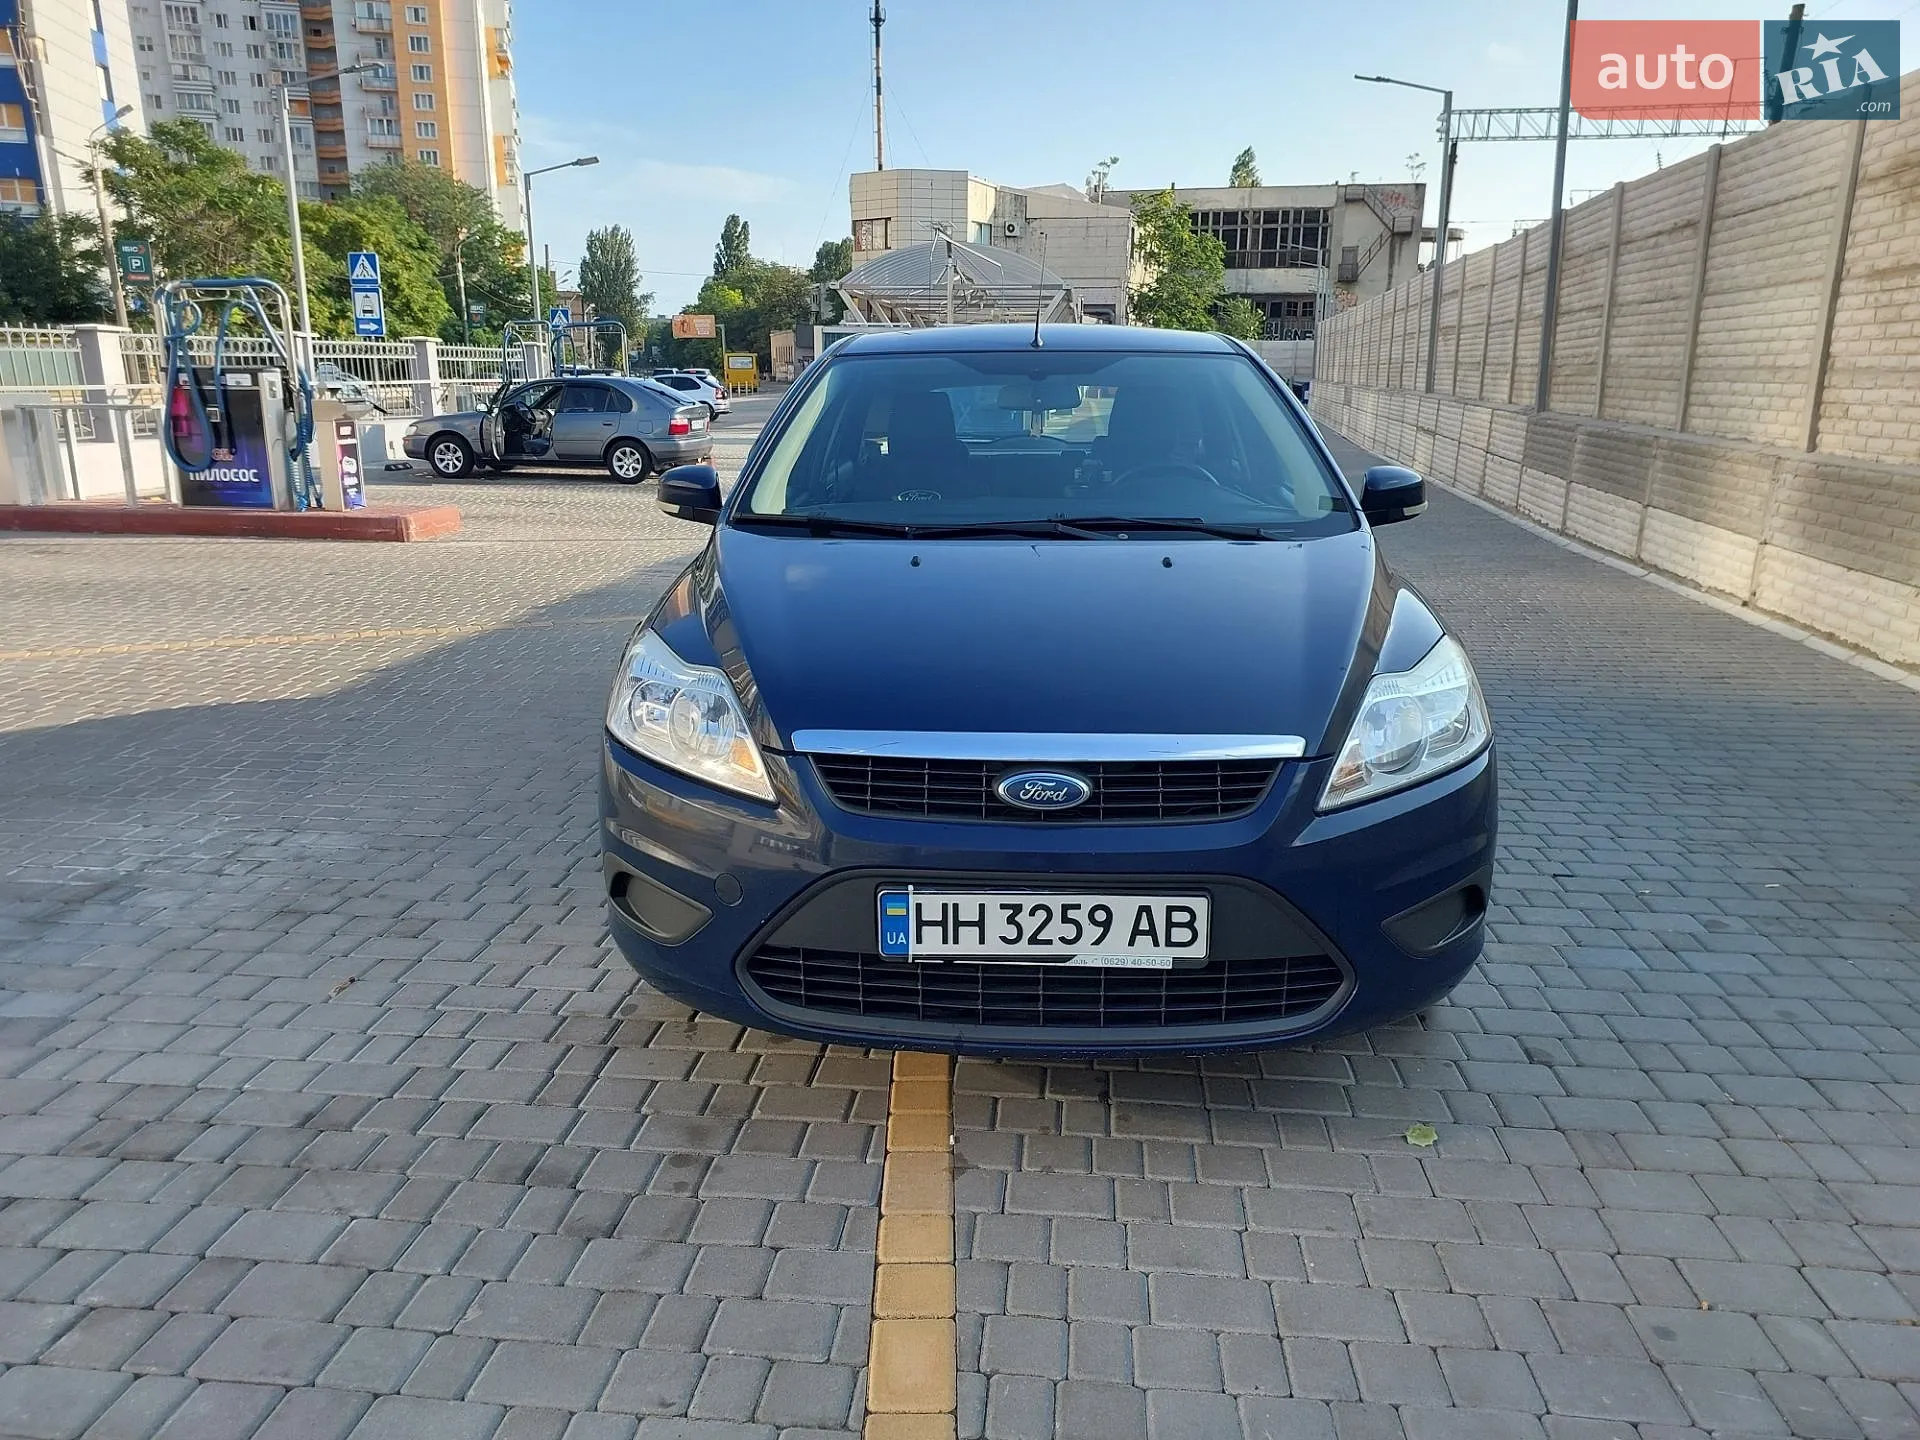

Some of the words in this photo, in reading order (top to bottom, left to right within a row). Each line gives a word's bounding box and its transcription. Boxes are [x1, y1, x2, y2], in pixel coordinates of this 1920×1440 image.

[1019, 780, 1068, 802] Ford
[915, 902, 985, 945] HH
[998, 903, 1114, 946] 3259
[1127, 904, 1199, 948] AB
[887, 932, 907, 945] UA
